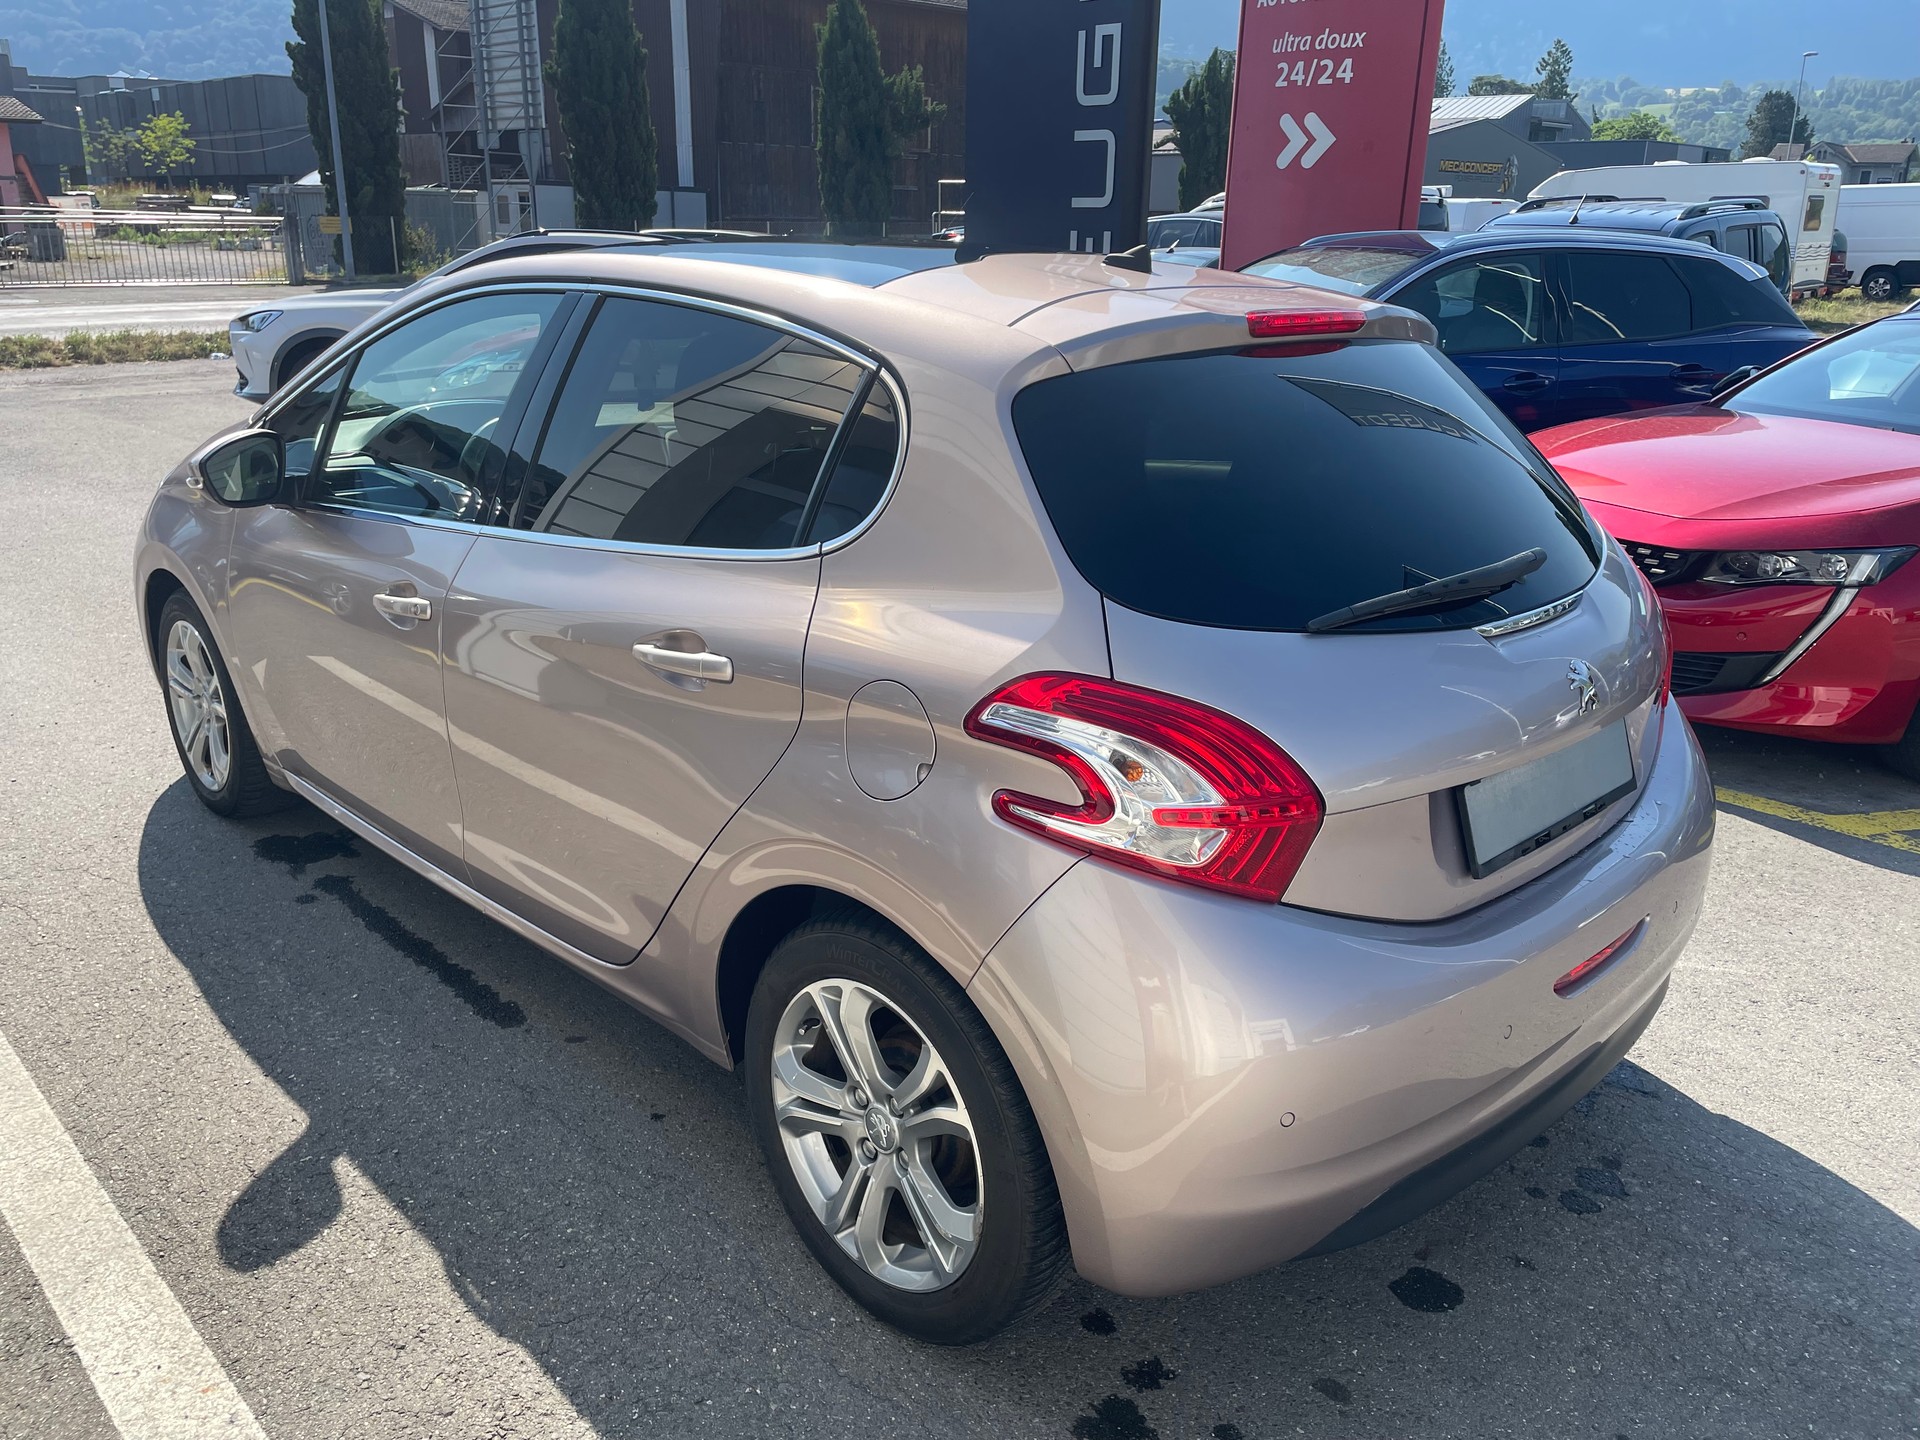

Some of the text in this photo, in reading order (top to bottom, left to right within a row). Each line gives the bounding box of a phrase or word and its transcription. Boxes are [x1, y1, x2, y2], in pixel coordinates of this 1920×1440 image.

[1272, 28, 1367, 54] ultra doux
[1275, 58, 1354, 88] 24/24
